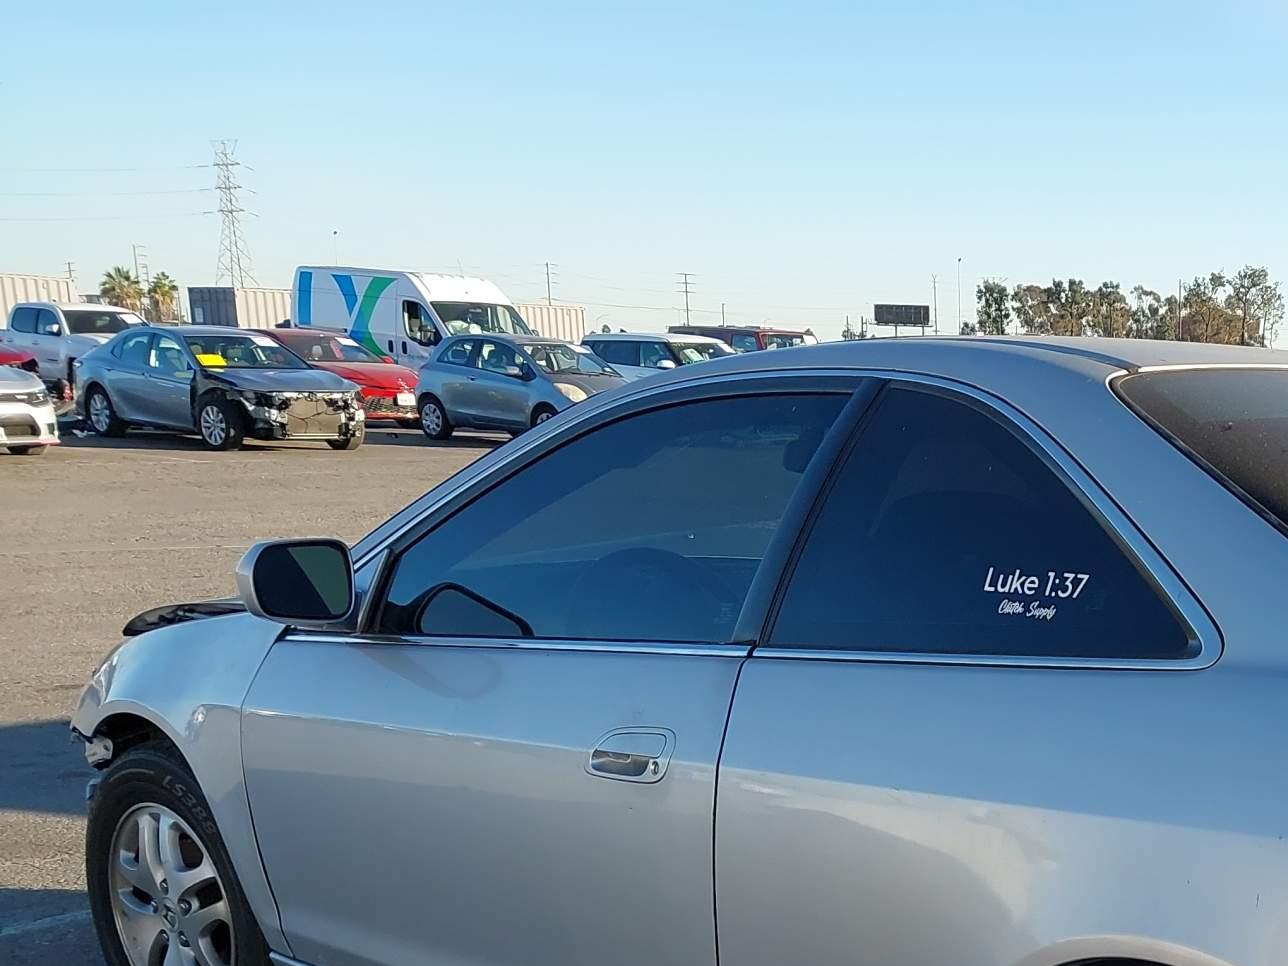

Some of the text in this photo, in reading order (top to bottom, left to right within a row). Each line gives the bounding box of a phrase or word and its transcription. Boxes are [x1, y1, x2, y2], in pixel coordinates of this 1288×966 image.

[984, 567, 1090, 599] Luke 1:37
[1025, 600, 1057, 621] Supply
